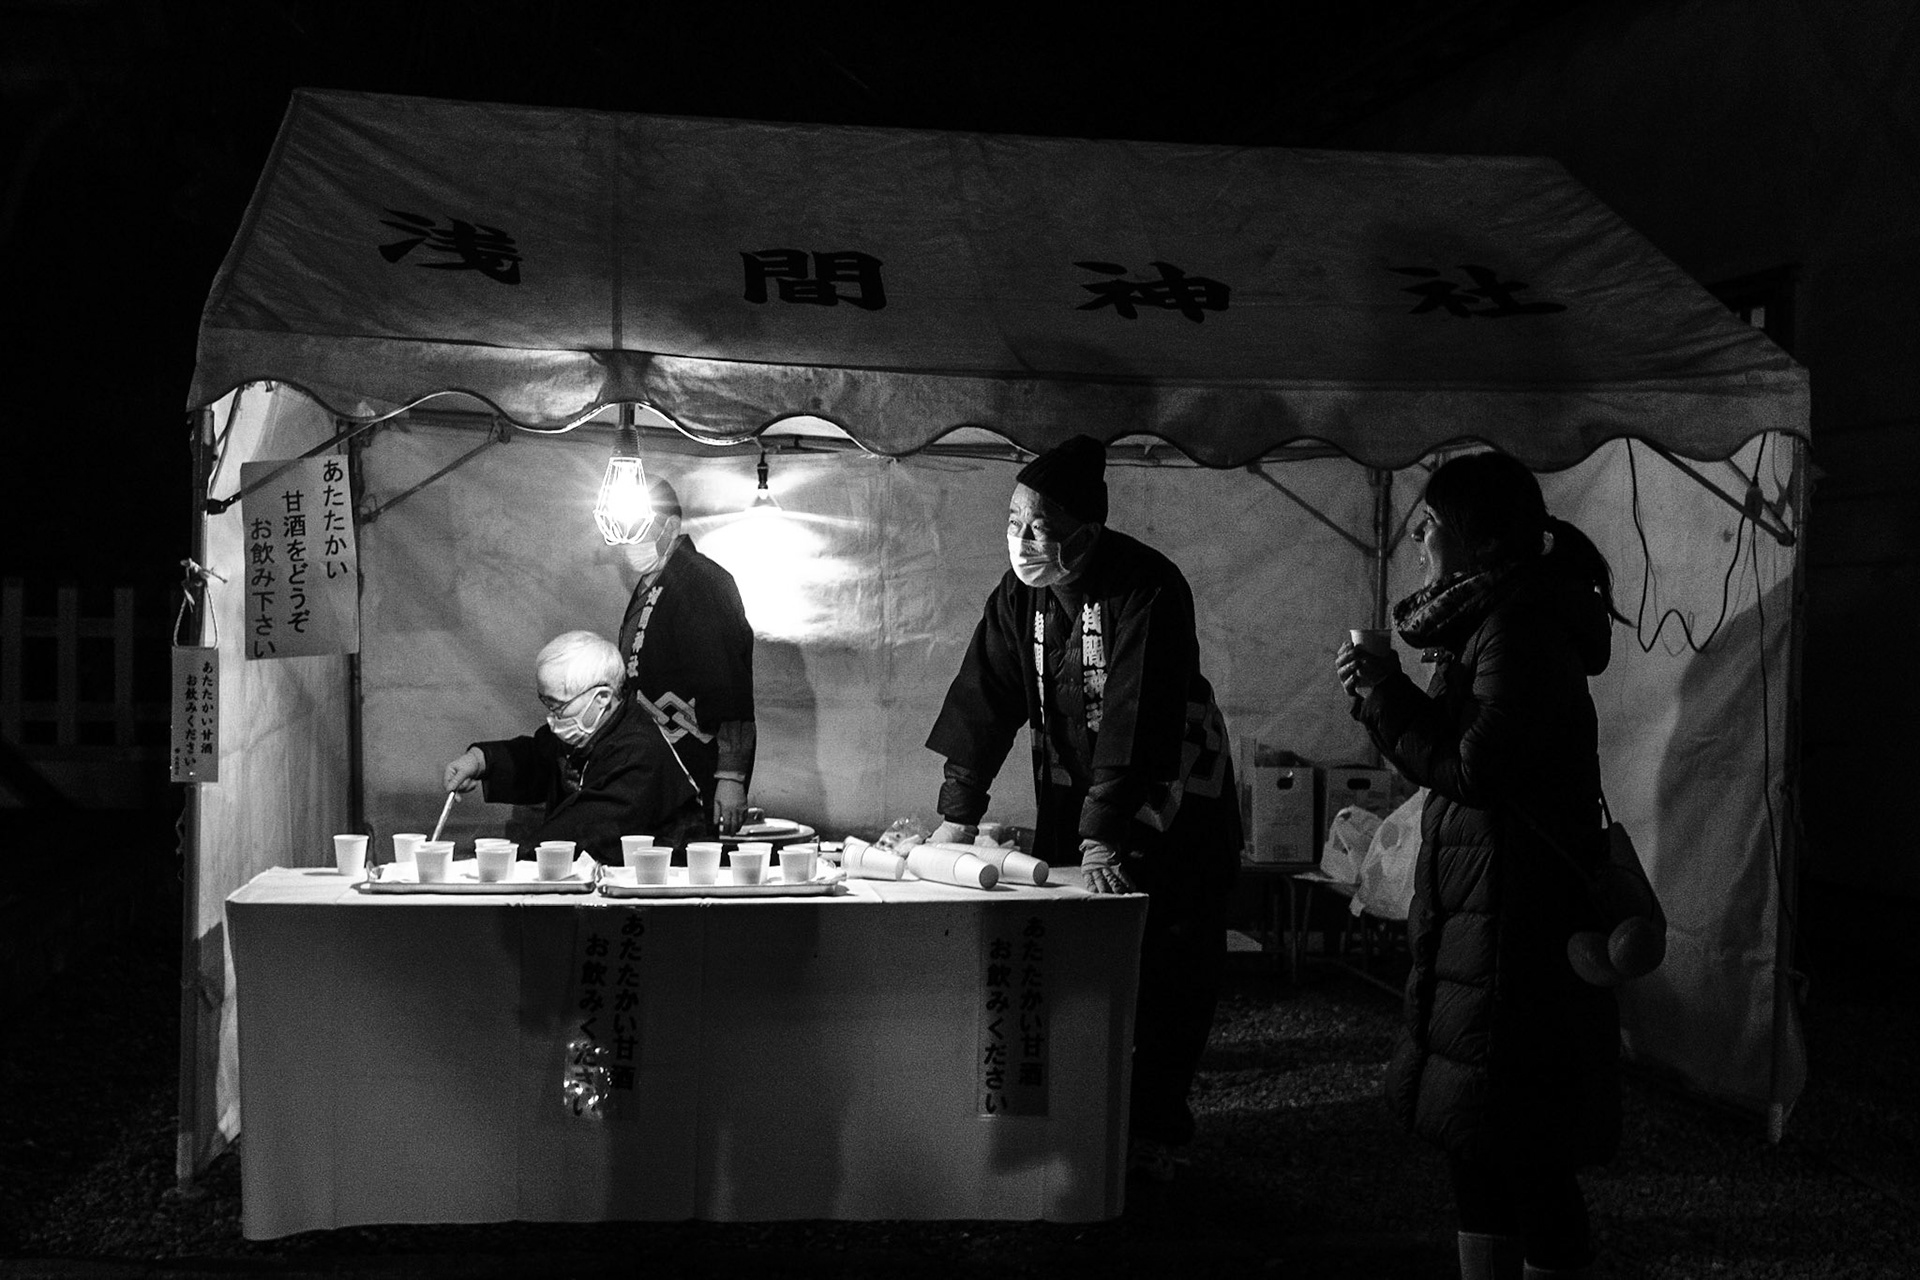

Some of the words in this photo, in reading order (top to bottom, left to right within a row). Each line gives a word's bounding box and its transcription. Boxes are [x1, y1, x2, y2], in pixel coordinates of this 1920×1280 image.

[378, 205, 1568, 323] 浅間神社
[250, 518, 277, 660] お飲み下さい
[281, 490, 311, 634] 甘酒をどうぞ
[322, 459, 349, 580] あたたかい
[184, 674, 198, 767] お飲みください
[200, 661, 214, 755] あたたかい甘酒
[611, 914, 645, 1091] あたたかい甘酒
[983, 937, 1012, 1114] お飲みください
[1018, 916, 1046, 1087] あたたかい甘酒
